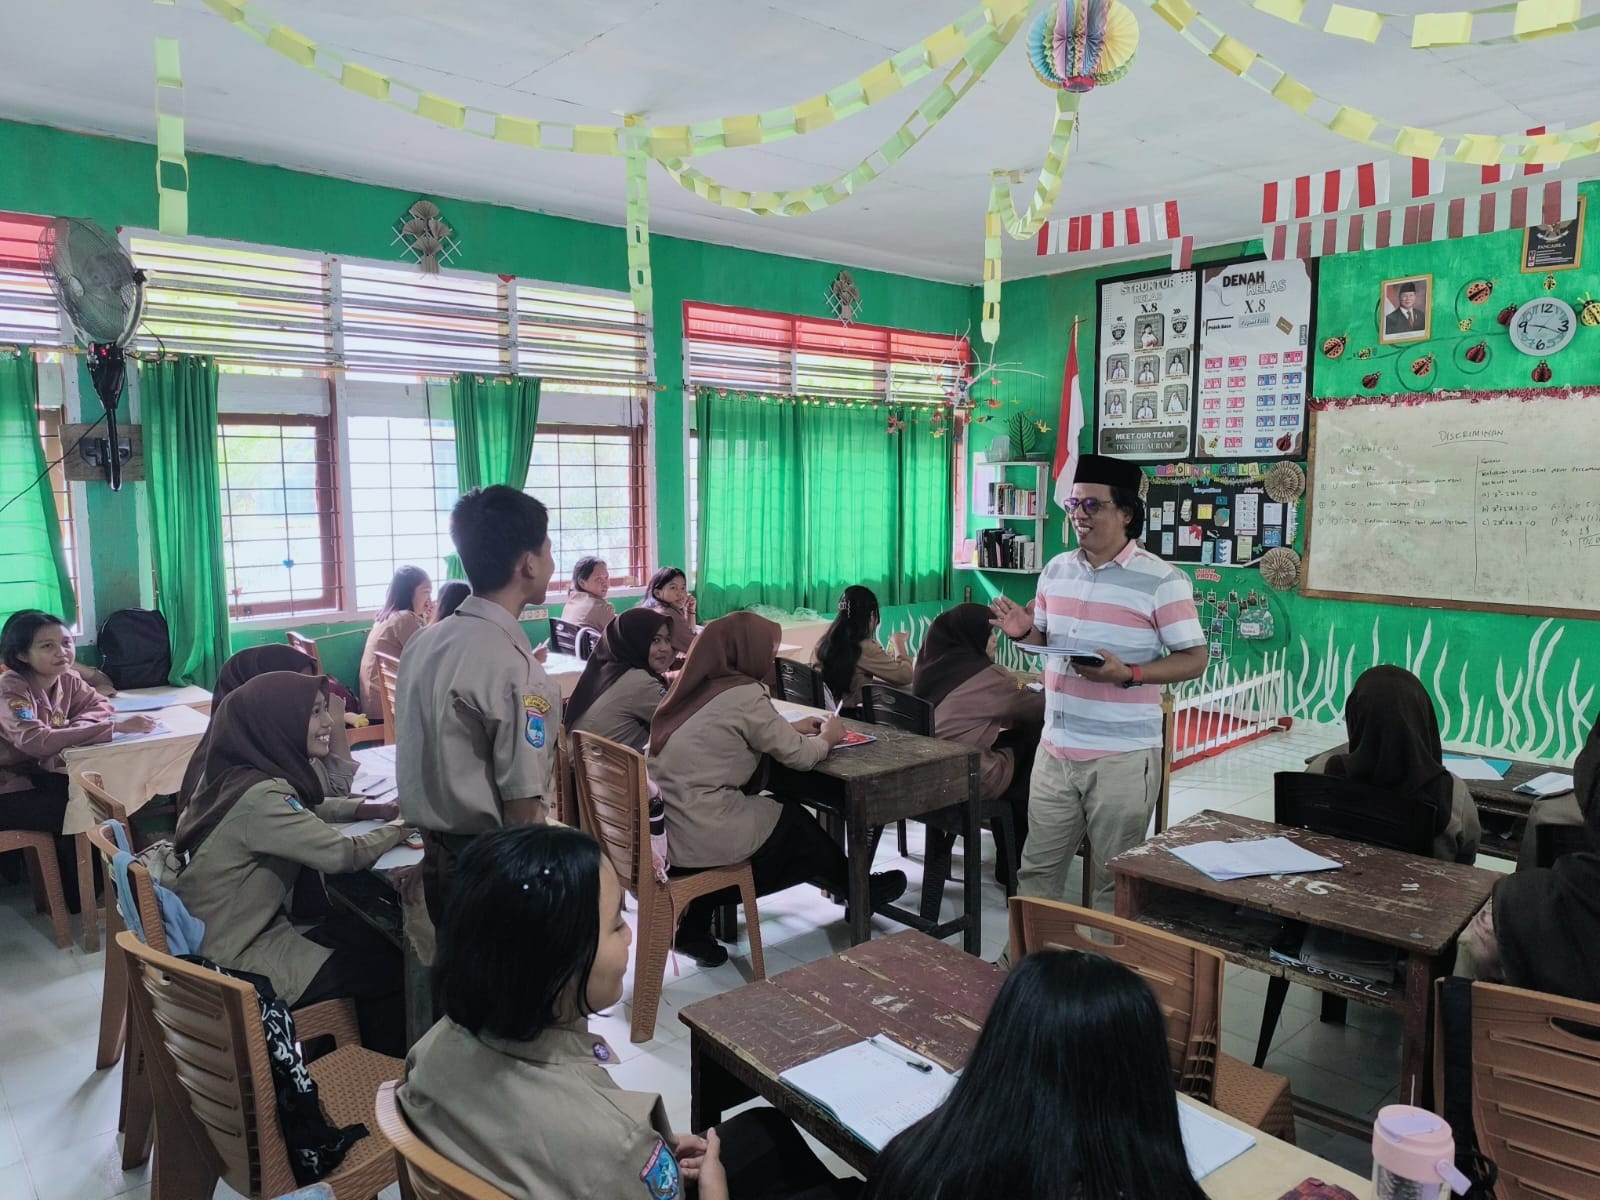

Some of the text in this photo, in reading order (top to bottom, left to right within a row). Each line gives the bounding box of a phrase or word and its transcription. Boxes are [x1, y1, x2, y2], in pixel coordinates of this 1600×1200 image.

[1223, 270, 1265, 288] DENAH
[1121, 279, 1175, 295] STRUKTUR
[1246, 279, 1287, 296] KELAS
[1141, 302, 1158, 314] X.8
[1244, 298, 1266, 314] X.8
[1541, 303, 1553, 313] 12
[1518, 321, 1528, 333] 9
[1557, 320, 1569, 332] 3
[1535, 339, 1545, 350] 6
[1155, 431, 1174, 439] TEAM
